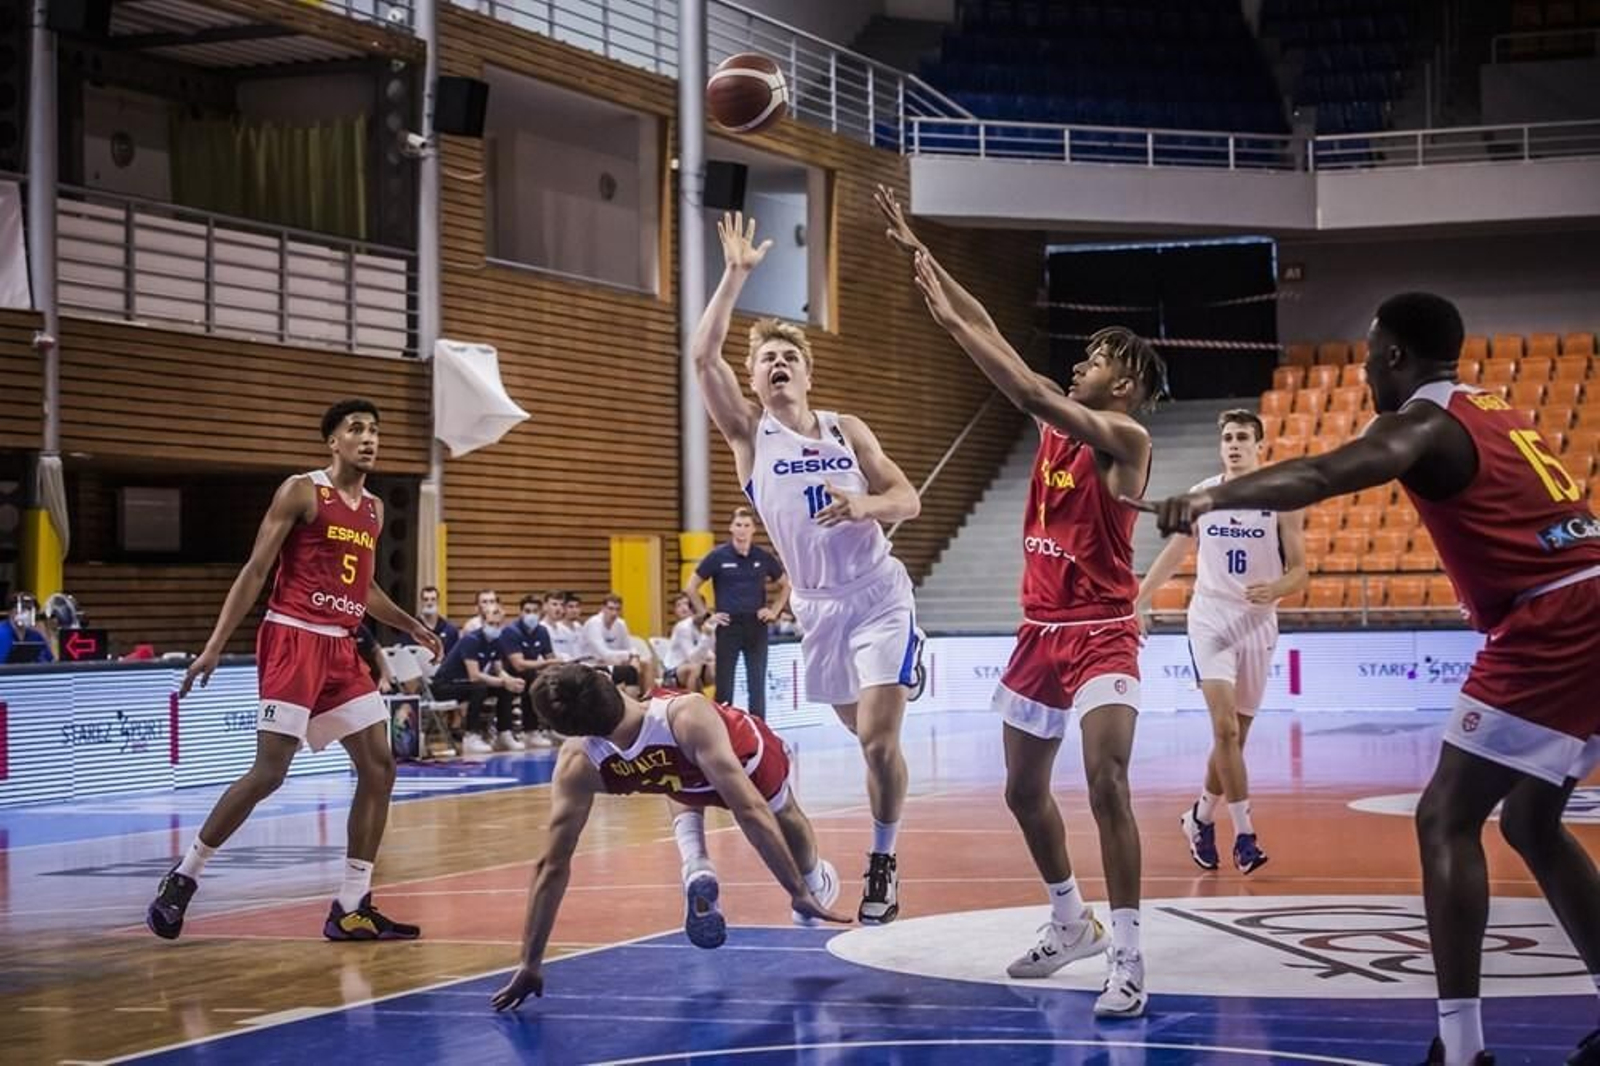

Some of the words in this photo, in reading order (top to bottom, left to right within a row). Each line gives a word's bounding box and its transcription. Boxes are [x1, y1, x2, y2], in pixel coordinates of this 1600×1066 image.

[773, 456, 853, 475] ČESKO
[1509, 430, 1580, 502] 15
[1207, 525, 1265, 538] ČESKO
[341, 554, 358, 584] 5
[1226, 549, 1247, 574] 16
